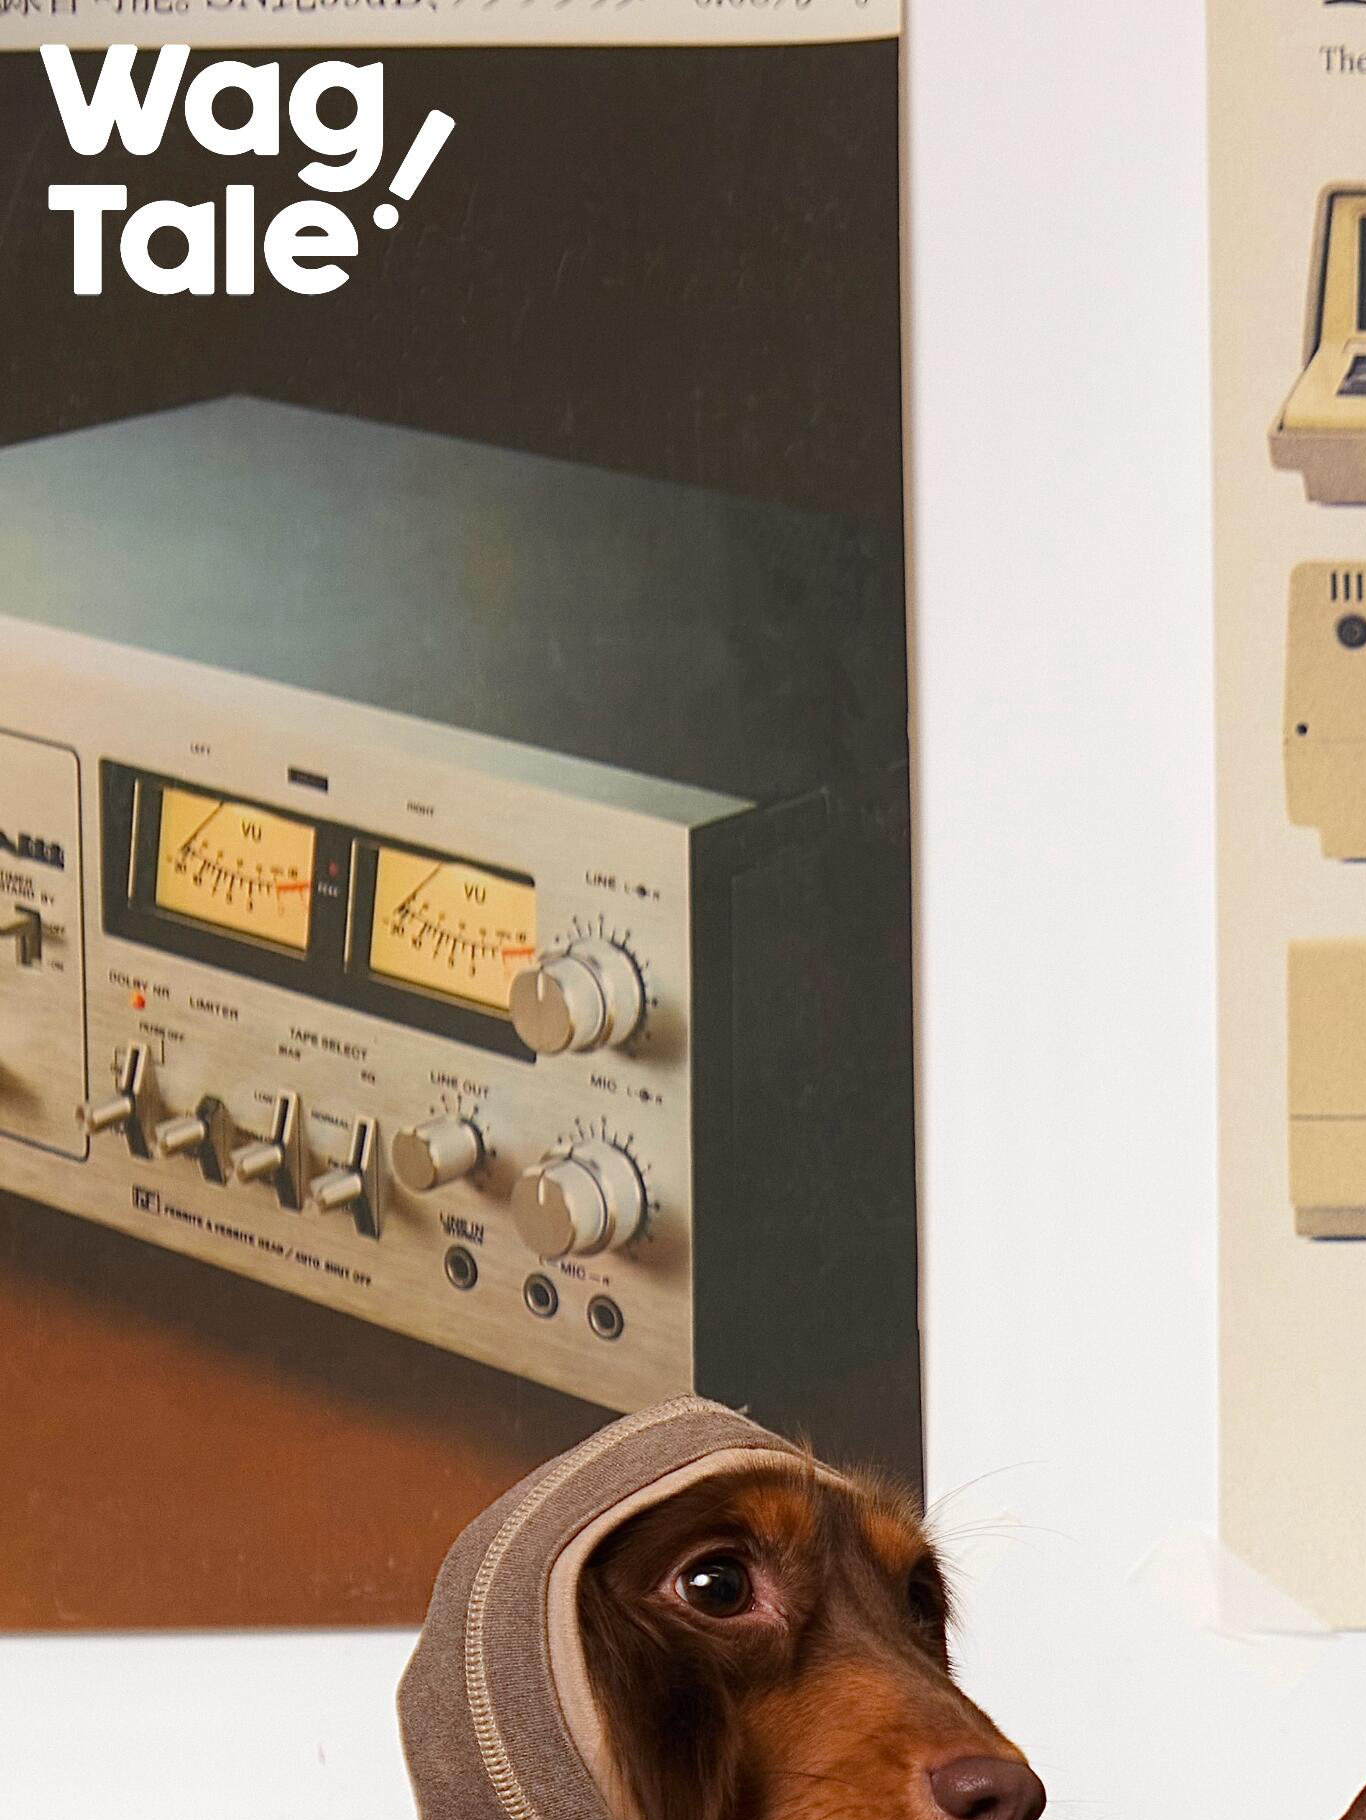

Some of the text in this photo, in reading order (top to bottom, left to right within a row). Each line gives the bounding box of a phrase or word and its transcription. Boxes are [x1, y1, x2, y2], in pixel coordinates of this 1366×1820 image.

[241, 820, 262, 842] VU
[464, 883, 486, 904] VU
[108, 969, 148, 991] DOLBY
[189, 995, 239, 1021] LIMITER
[289, 1027, 368, 1061] TAPE SELECT
[430, 1070, 489, 1099] LINE OUT
[590, 1073, 617, 1092] MIC
[560, 1261, 586, 1281] MIC
